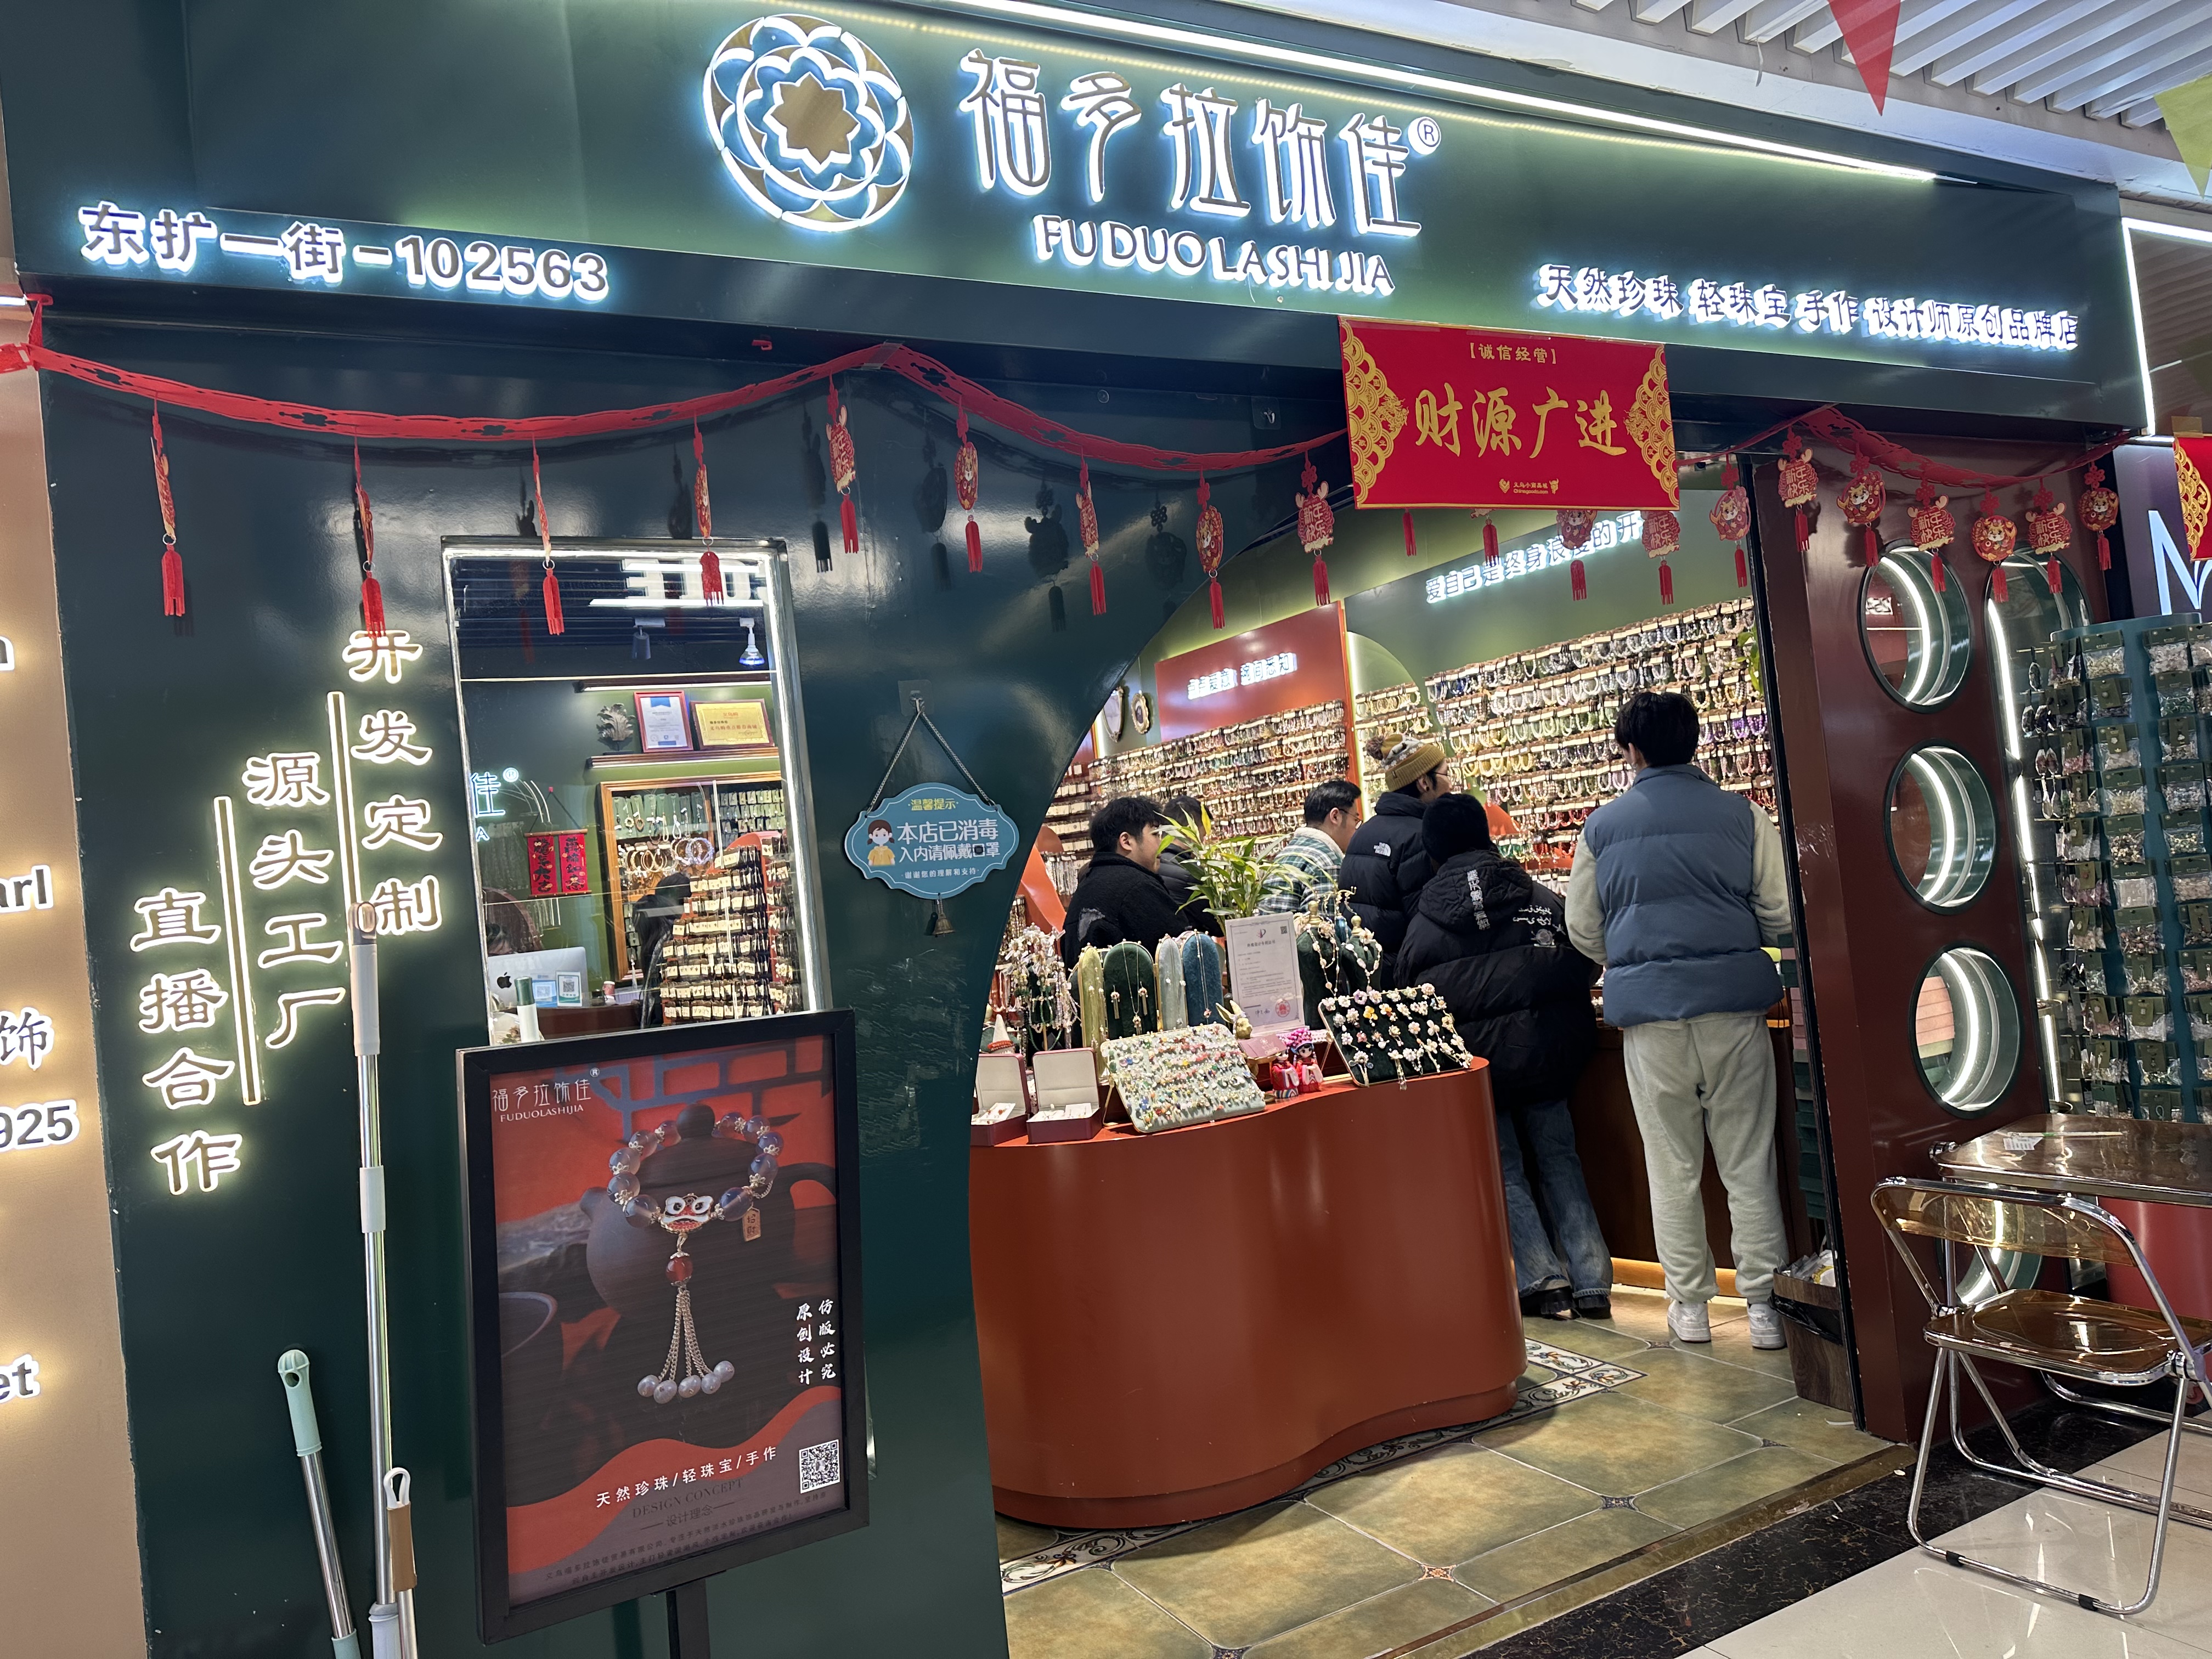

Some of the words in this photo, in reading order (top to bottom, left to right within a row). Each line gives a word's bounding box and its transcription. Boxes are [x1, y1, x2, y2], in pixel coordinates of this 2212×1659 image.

[960, 48, 1421, 236] 福多拉饰佳
[78, 201, 611, 302] 东扩一街-102563
[1537, 263, 1684, 320] 天然珍珠
[1689, 278, 1792, 328] 轻珠宝
[1795, 289, 1860, 334] 手作
[1864, 297, 2079, 351] 设计师原创品牌店
[1415, 382, 1627, 459] 财源广进
[342, 630, 443, 935] 开发定制
[911, 798, 956, 811] 温馨提示
[897, 819, 998, 844] 本店已消毒
[899, 842, 1000, 863] 入内请佩戴口罩
[241, 752, 346, 1049] 源头工厂
[129, 887, 242, 1196] 直播合作
[492, 1079, 591, 1113] 福多拉饰佳
[500, 1104, 584, 1122] FUDUOLASHIJIA
[796, 1303, 814, 1385] 原创设计
[818, 1299, 836, 1381] 仿版必究
[596, 1446, 777, 1509] 天然珍珠/轻珠宝/手作
[631, 1494, 681, 1519] DESIGN
[685, 1478, 744, 1505] CONCEPT
[664, 1505, 714, 1529] 设计理念
